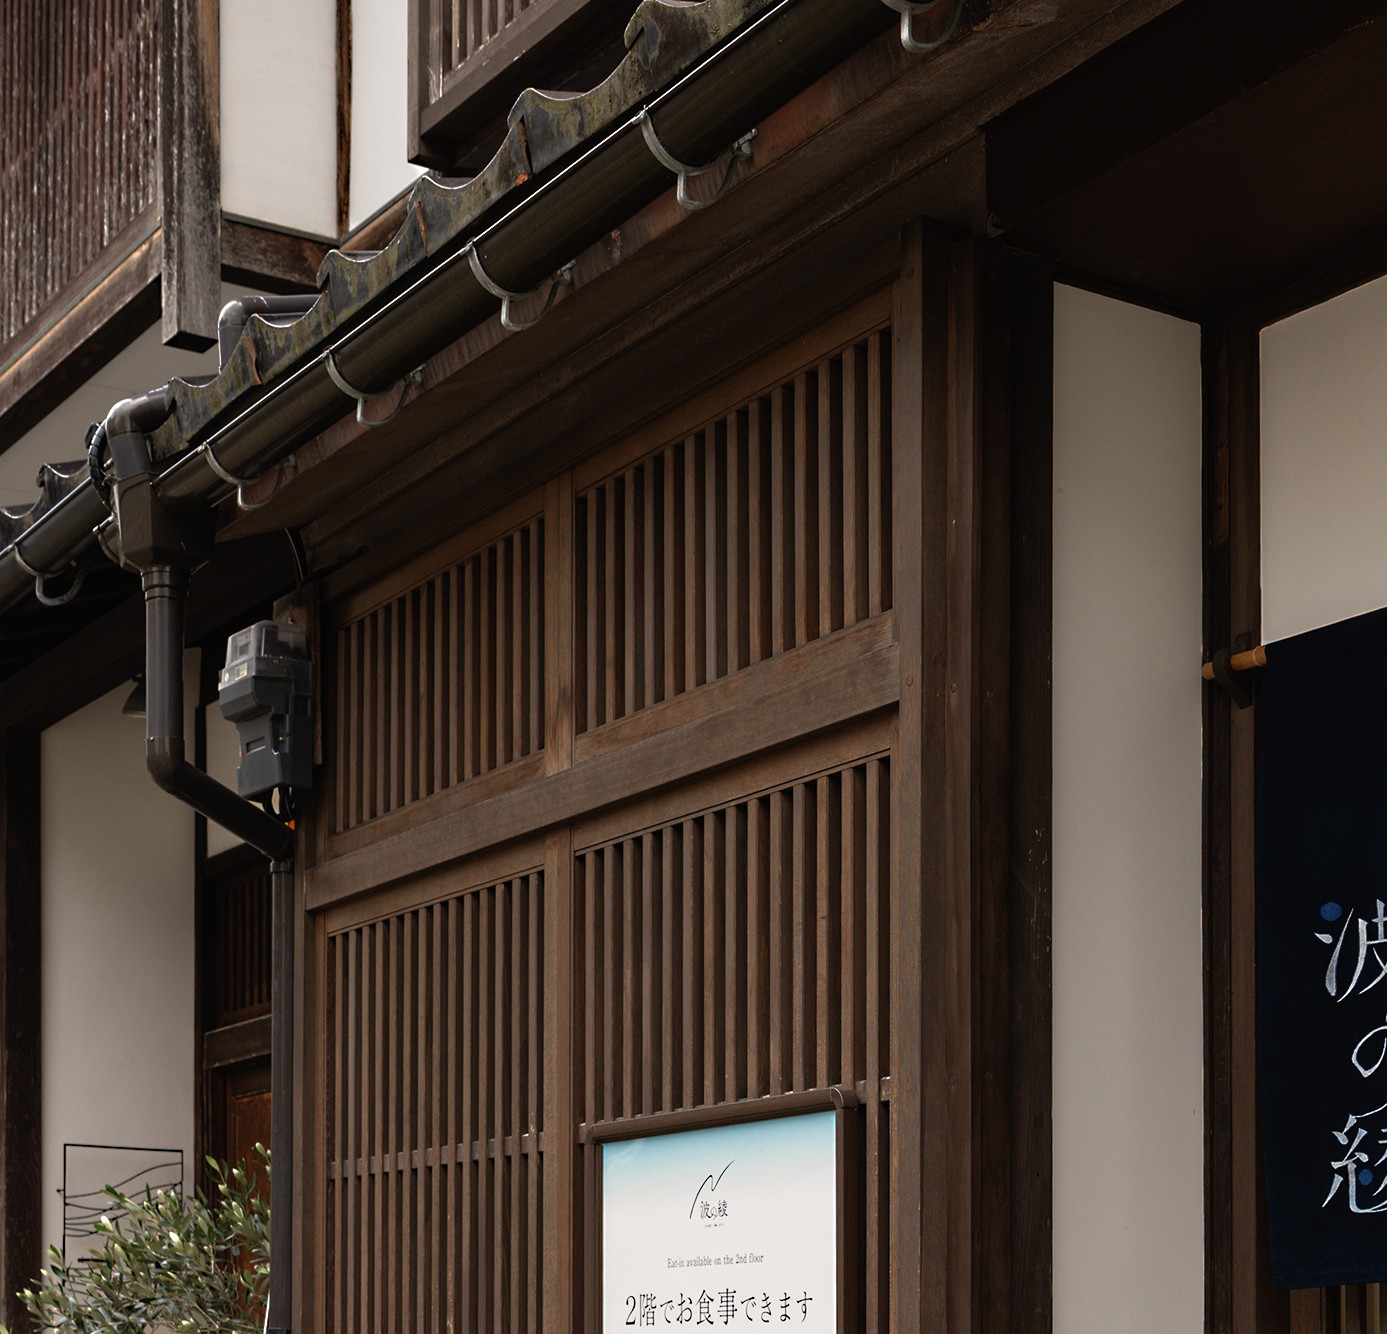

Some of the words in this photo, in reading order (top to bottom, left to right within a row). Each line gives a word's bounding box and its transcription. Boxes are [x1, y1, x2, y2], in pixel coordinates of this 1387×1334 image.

[699, 1199, 729, 1220] 波の綾
[668, 1258, 685, 1268] Eat-in
[687, 1256, 712, 1267] available
[724, 1254, 734, 1264] the
[736, 1253, 747, 1264] 2nd
[750, 1253, 764, 1263] floor
[624, 1288, 814, 1327] 2階でお食事できます
